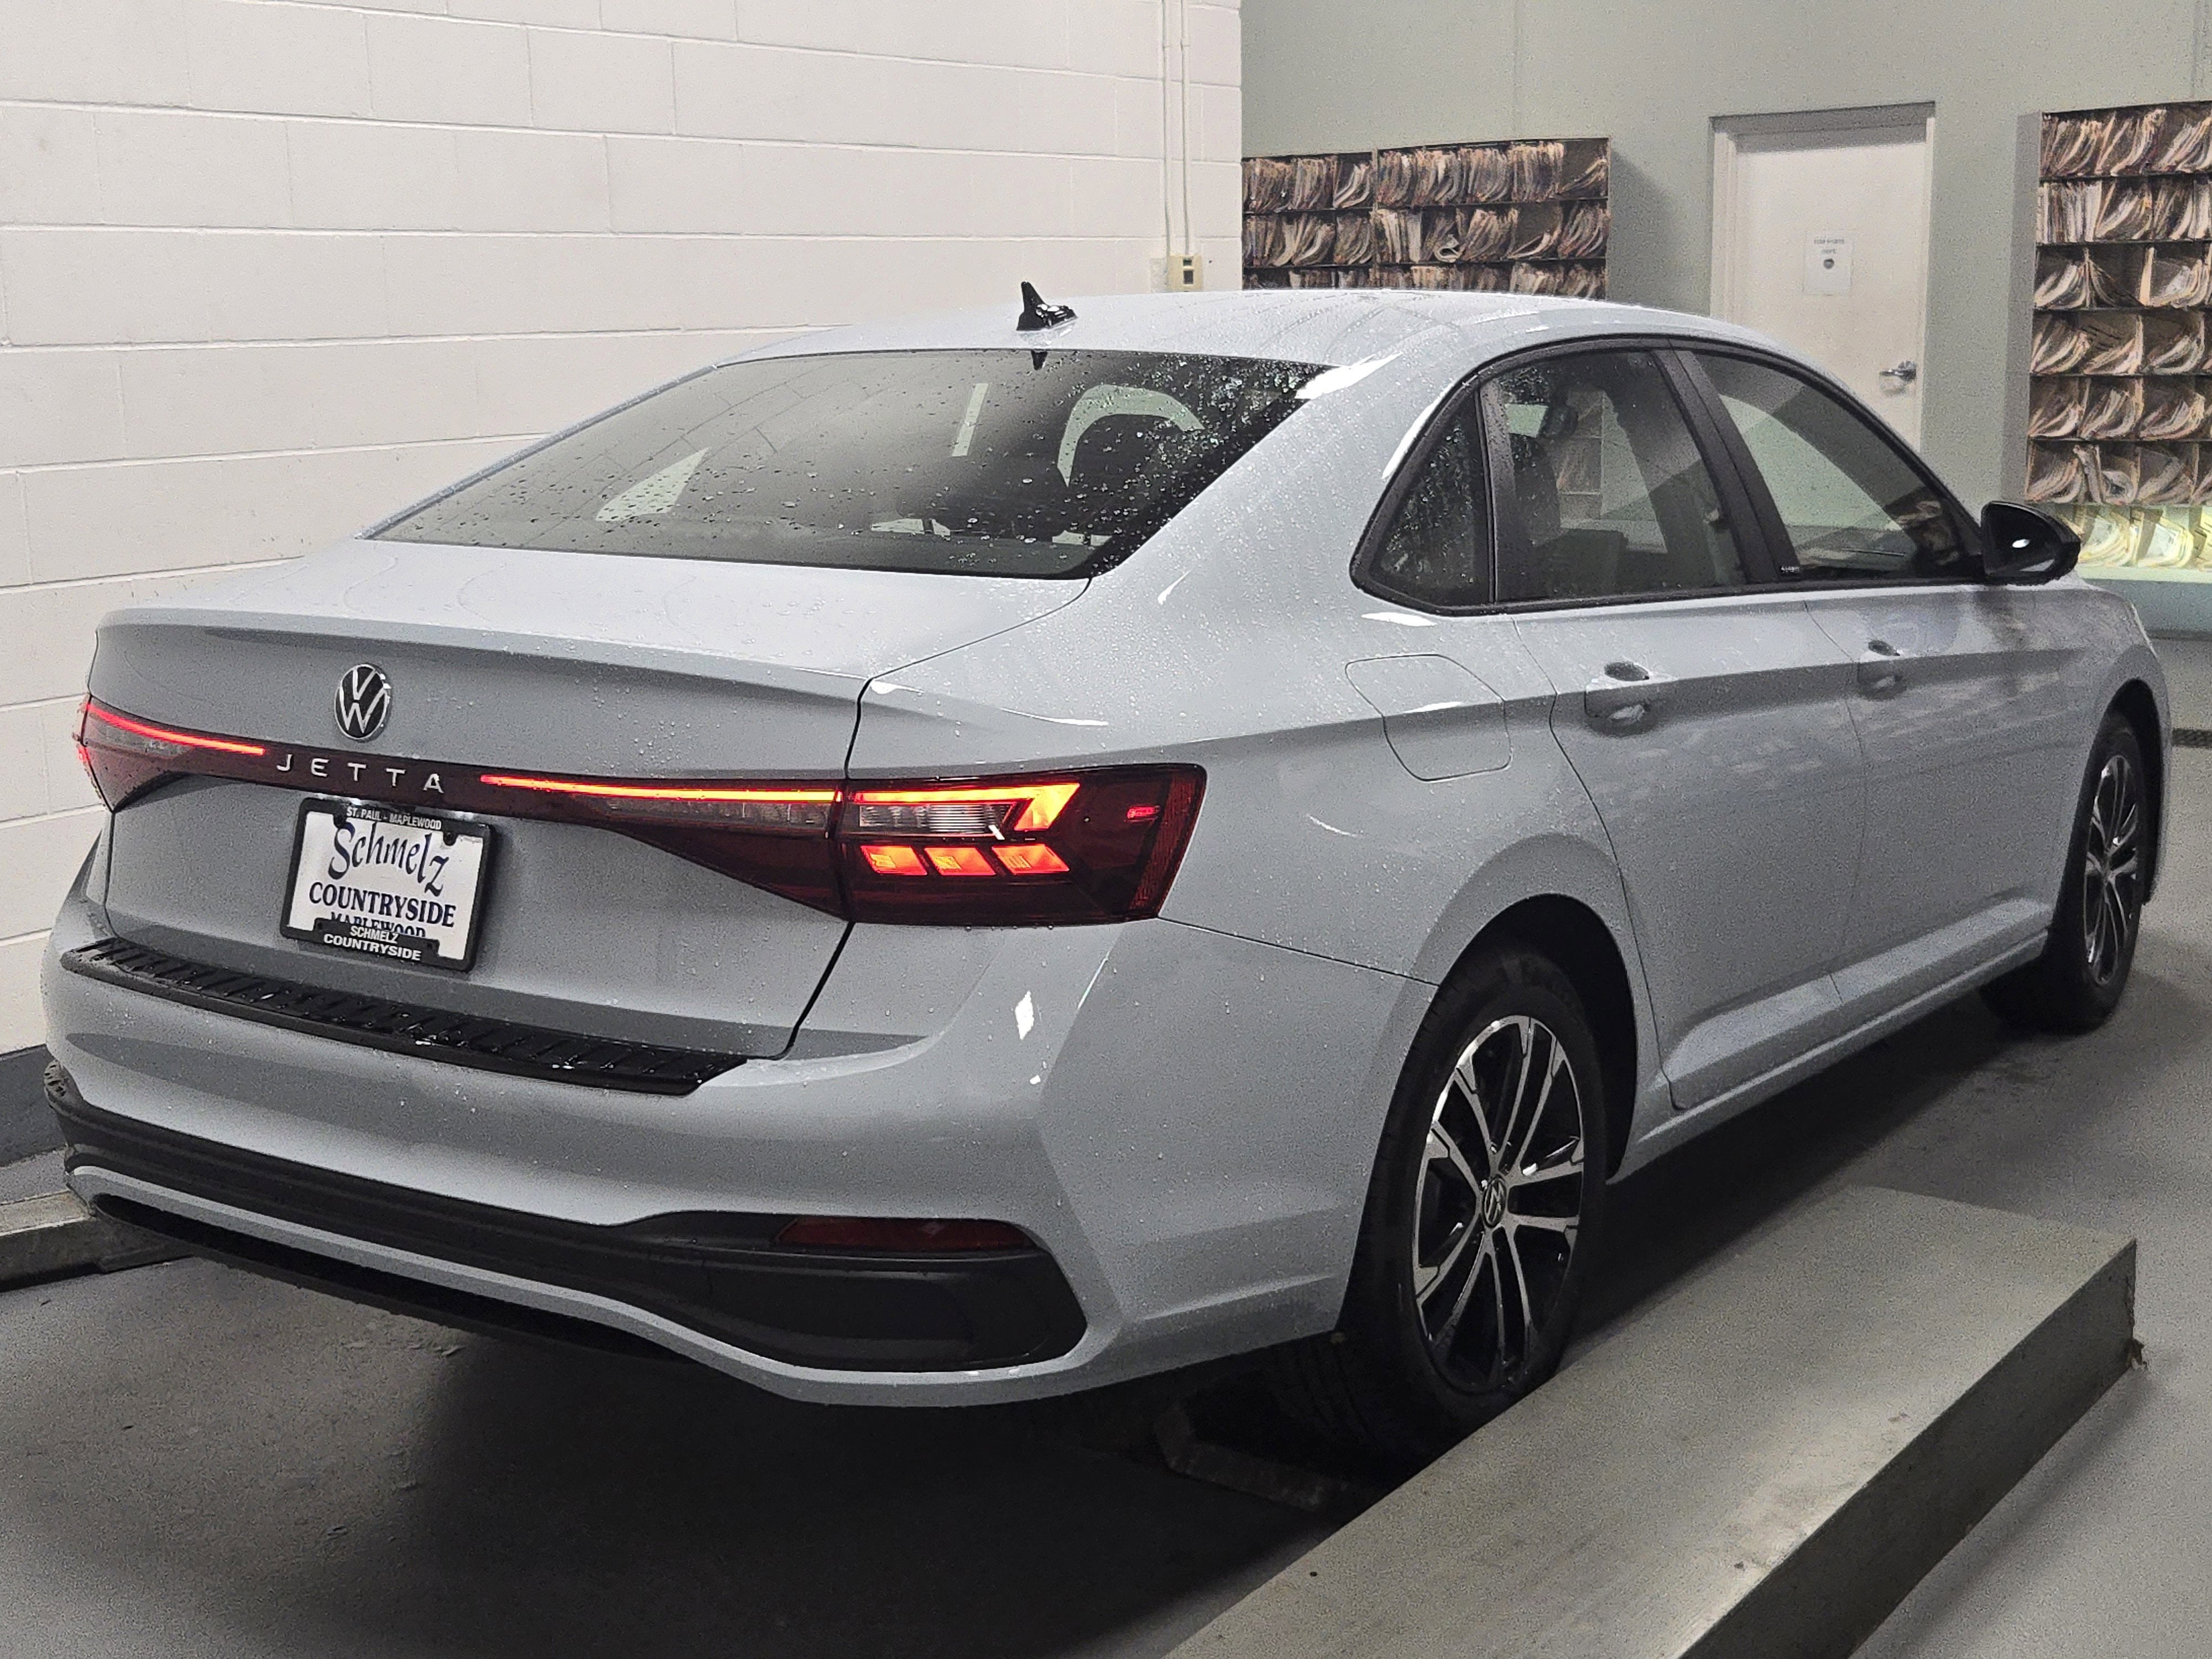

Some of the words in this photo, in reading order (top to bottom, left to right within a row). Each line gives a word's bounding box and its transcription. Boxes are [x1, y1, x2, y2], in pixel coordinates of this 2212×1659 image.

[276, 754, 444, 794] JETTA
[346, 806, 359, 817] ST.
[361, 808, 382, 821] PAUL
[389, 813, 442, 830] MAPLEWOOD
[328, 822, 449, 897] Schmelz
[309, 882, 457, 927] COUNTRYSIDE
[324, 933, 422, 961] COUNTRYSIDE
[349, 926, 399, 944] SCHMELZ
